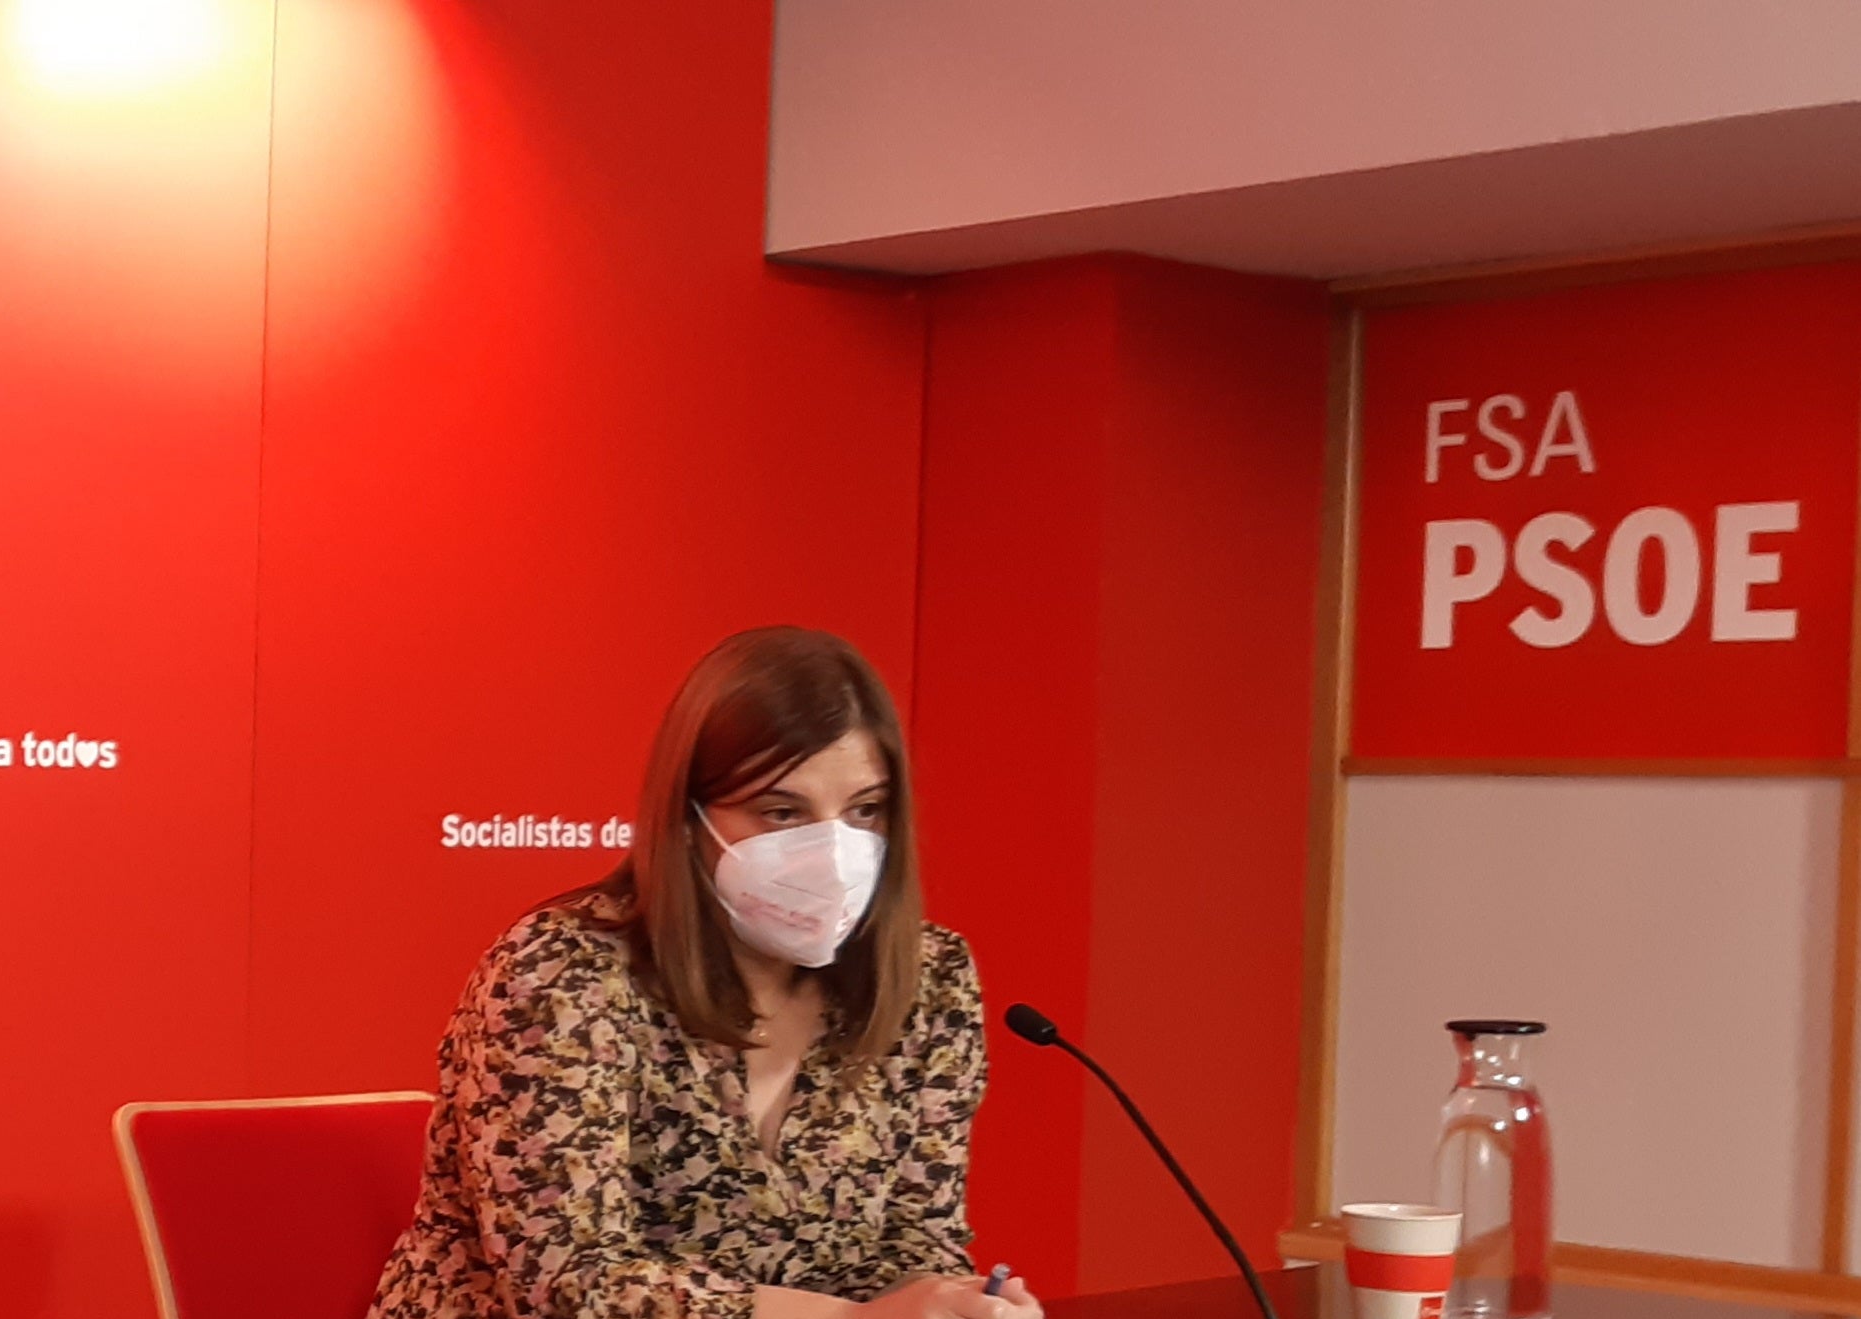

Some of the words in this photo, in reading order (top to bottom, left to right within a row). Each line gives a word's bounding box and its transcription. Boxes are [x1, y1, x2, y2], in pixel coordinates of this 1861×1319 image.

[1424, 390, 1597, 483] FSA
[1420, 500, 1801, 649] PSOE
[440, 813, 594, 848] Socialistas
[599, 815, 634, 849] de
